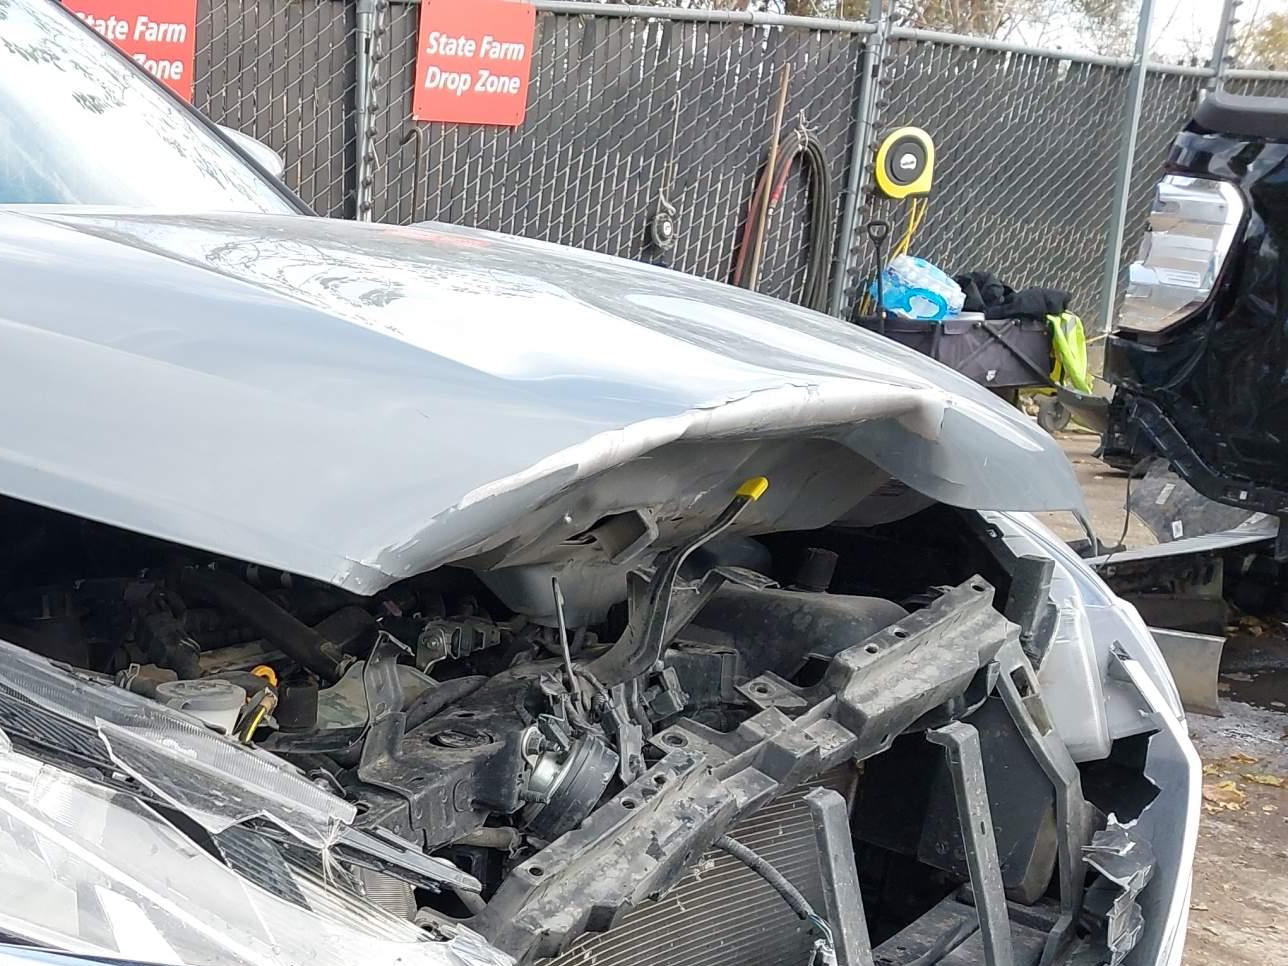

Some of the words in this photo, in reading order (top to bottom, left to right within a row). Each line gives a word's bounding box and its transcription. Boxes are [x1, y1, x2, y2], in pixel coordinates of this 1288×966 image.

[133, 16, 187, 42] Farm
[426, 31, 476, 57] State
[479, 35, 525, 60] Farm
[424, 65, 472, 96] Drop
[474, 69, 521, 94] Zone
